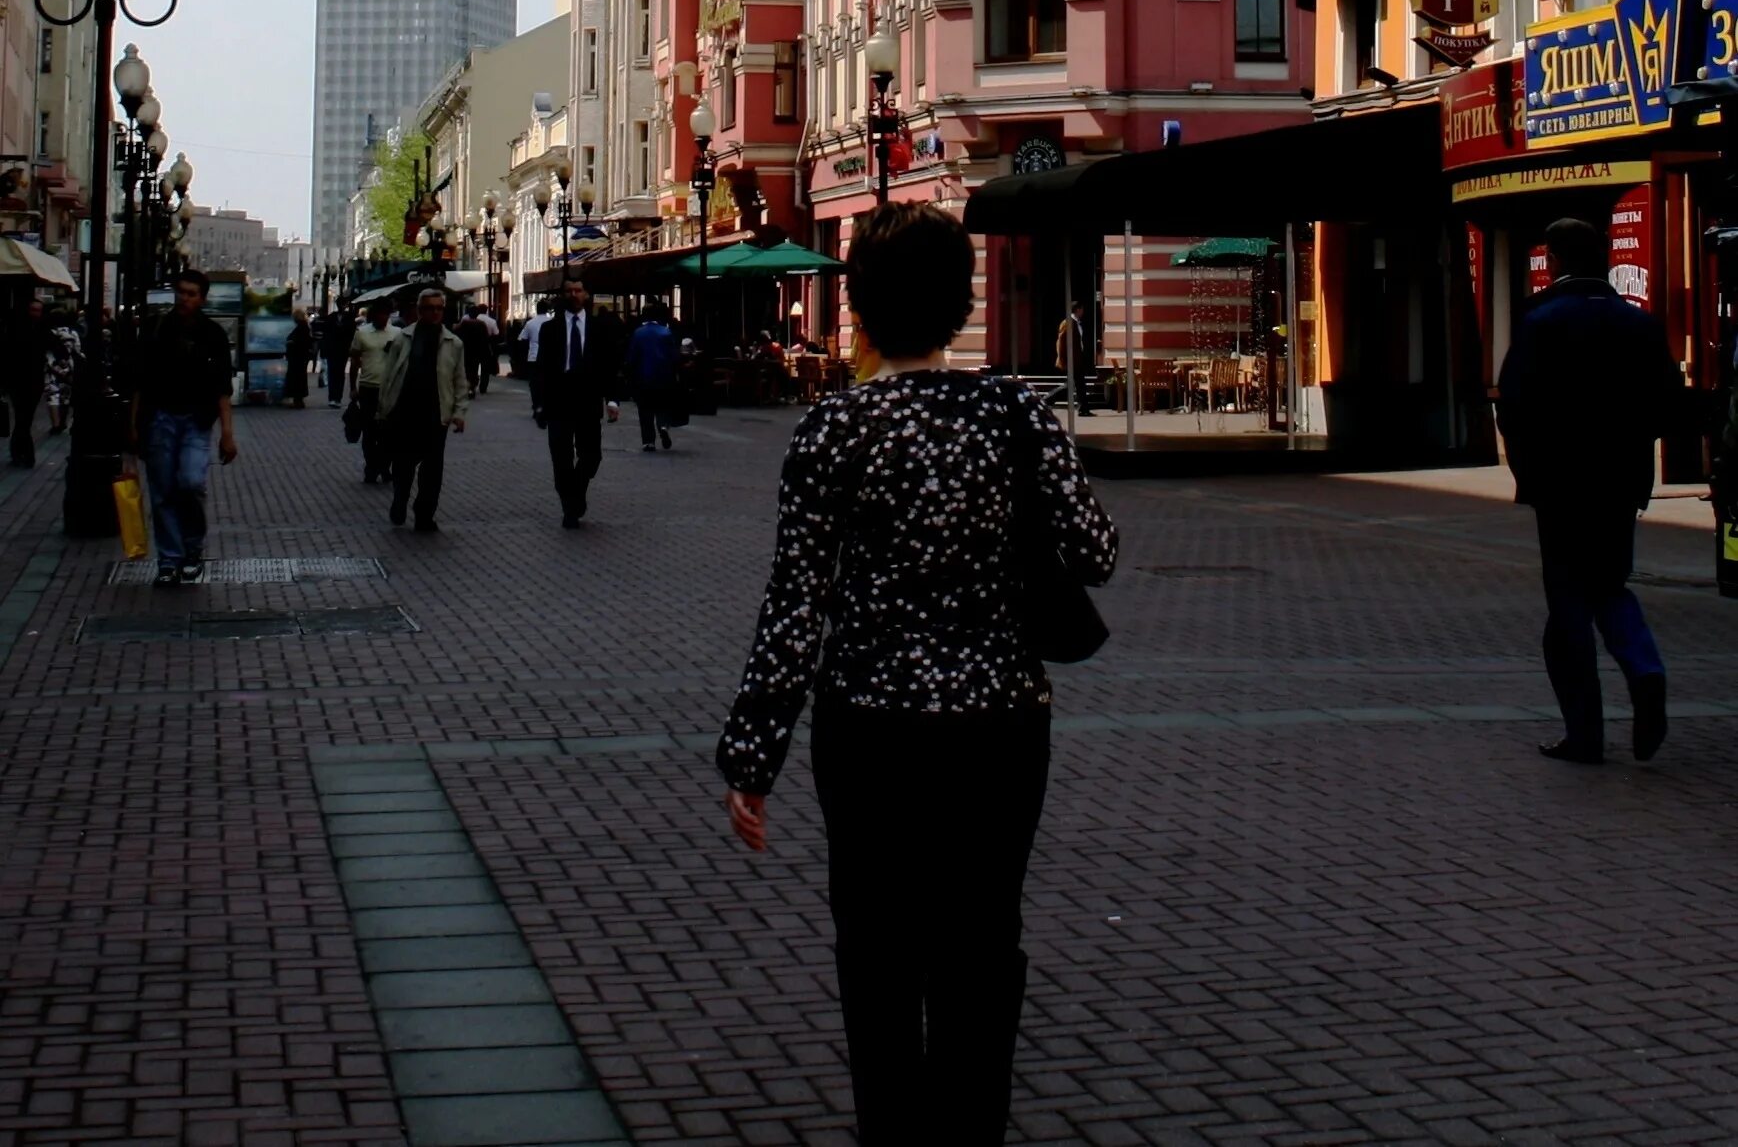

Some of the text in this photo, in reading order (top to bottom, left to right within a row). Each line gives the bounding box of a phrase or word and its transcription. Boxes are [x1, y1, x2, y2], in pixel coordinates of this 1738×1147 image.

[1434, 36, 1488, 48] ПОКУПКА
[1539, 106, 1632, 134] СЕТЬ ЮВЕЛИРНЫ
